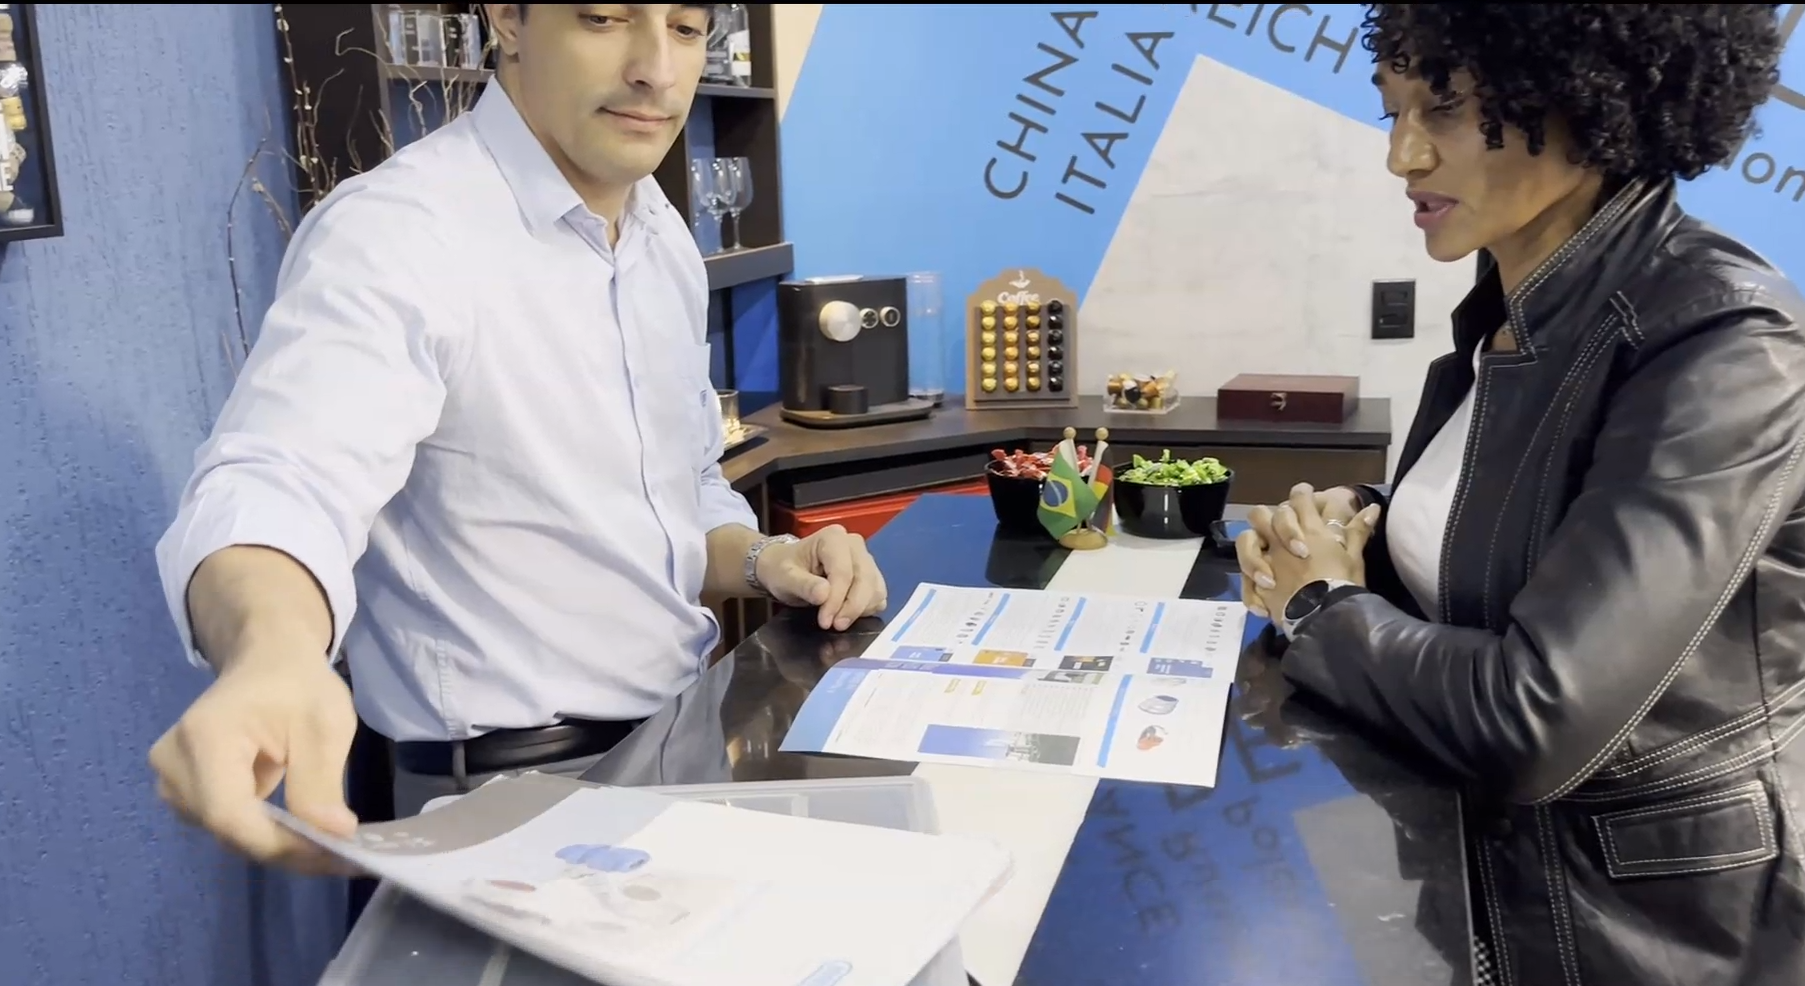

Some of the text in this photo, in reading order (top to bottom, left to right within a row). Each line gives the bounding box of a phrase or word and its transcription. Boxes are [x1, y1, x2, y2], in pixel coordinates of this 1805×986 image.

[1190, 4, 1359, 74] EICH
[984, 11, 1099, 199] CHINA
[1055, 31, 1175, 214] ITALIA
[998, 291, 1040, 306] Coffee
